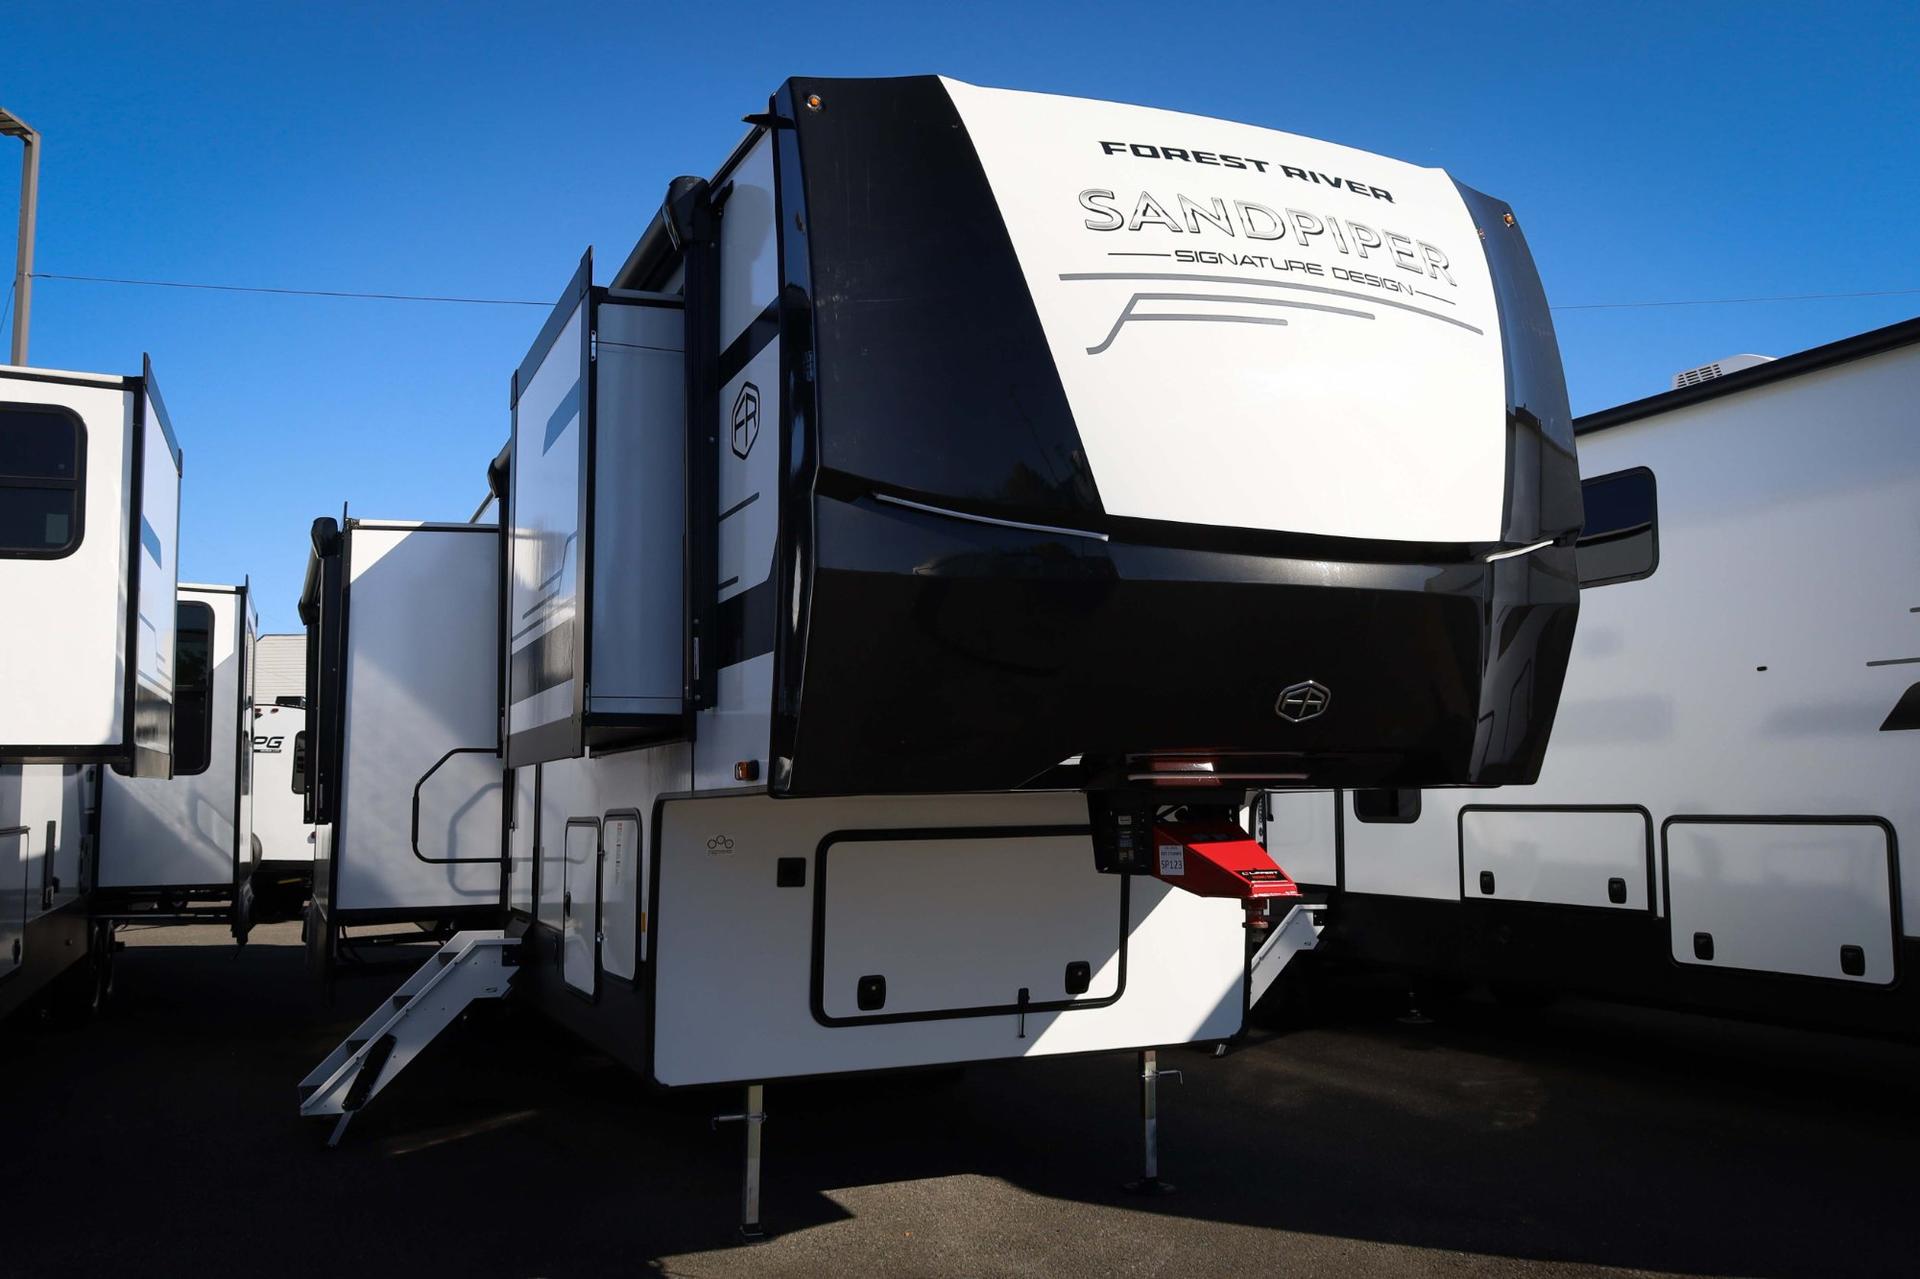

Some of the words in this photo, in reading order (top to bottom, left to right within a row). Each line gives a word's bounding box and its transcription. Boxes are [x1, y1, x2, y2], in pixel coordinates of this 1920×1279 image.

[1099, 140, 1269, 173] FOREST
[1279, 164, 1396, 204] RIVER
[1078, 188, 1457, 286] SANDPIPER
[1175, 250, 1325, 275] SIGNATURE
[1333, 267, 1414, 296] DESIGN
